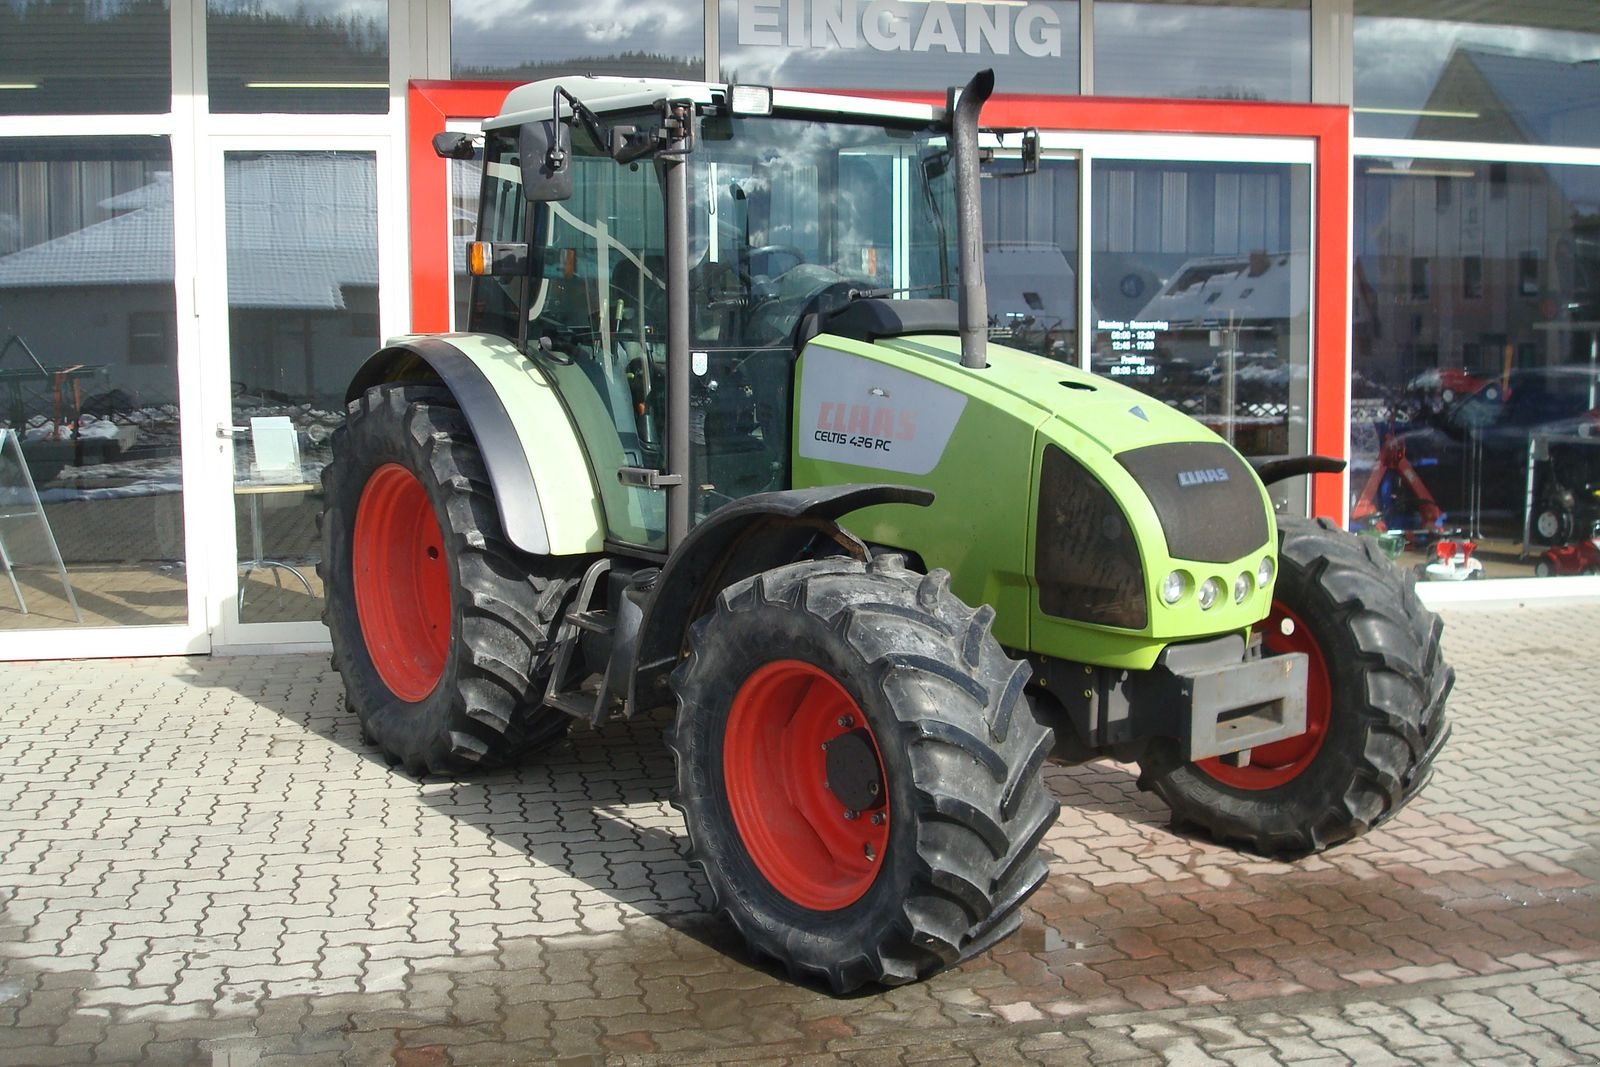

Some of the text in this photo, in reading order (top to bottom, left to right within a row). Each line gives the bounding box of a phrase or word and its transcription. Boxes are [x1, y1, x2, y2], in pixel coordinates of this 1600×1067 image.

[737, 0, 1061, 57] EINGANG
[816, 401, 918, 441] CLAAS
[814, 430, 847, 445] CELTIS
[874, 439, 892, 452] RC
[1178, 468, 1229, 486] CLAAS
